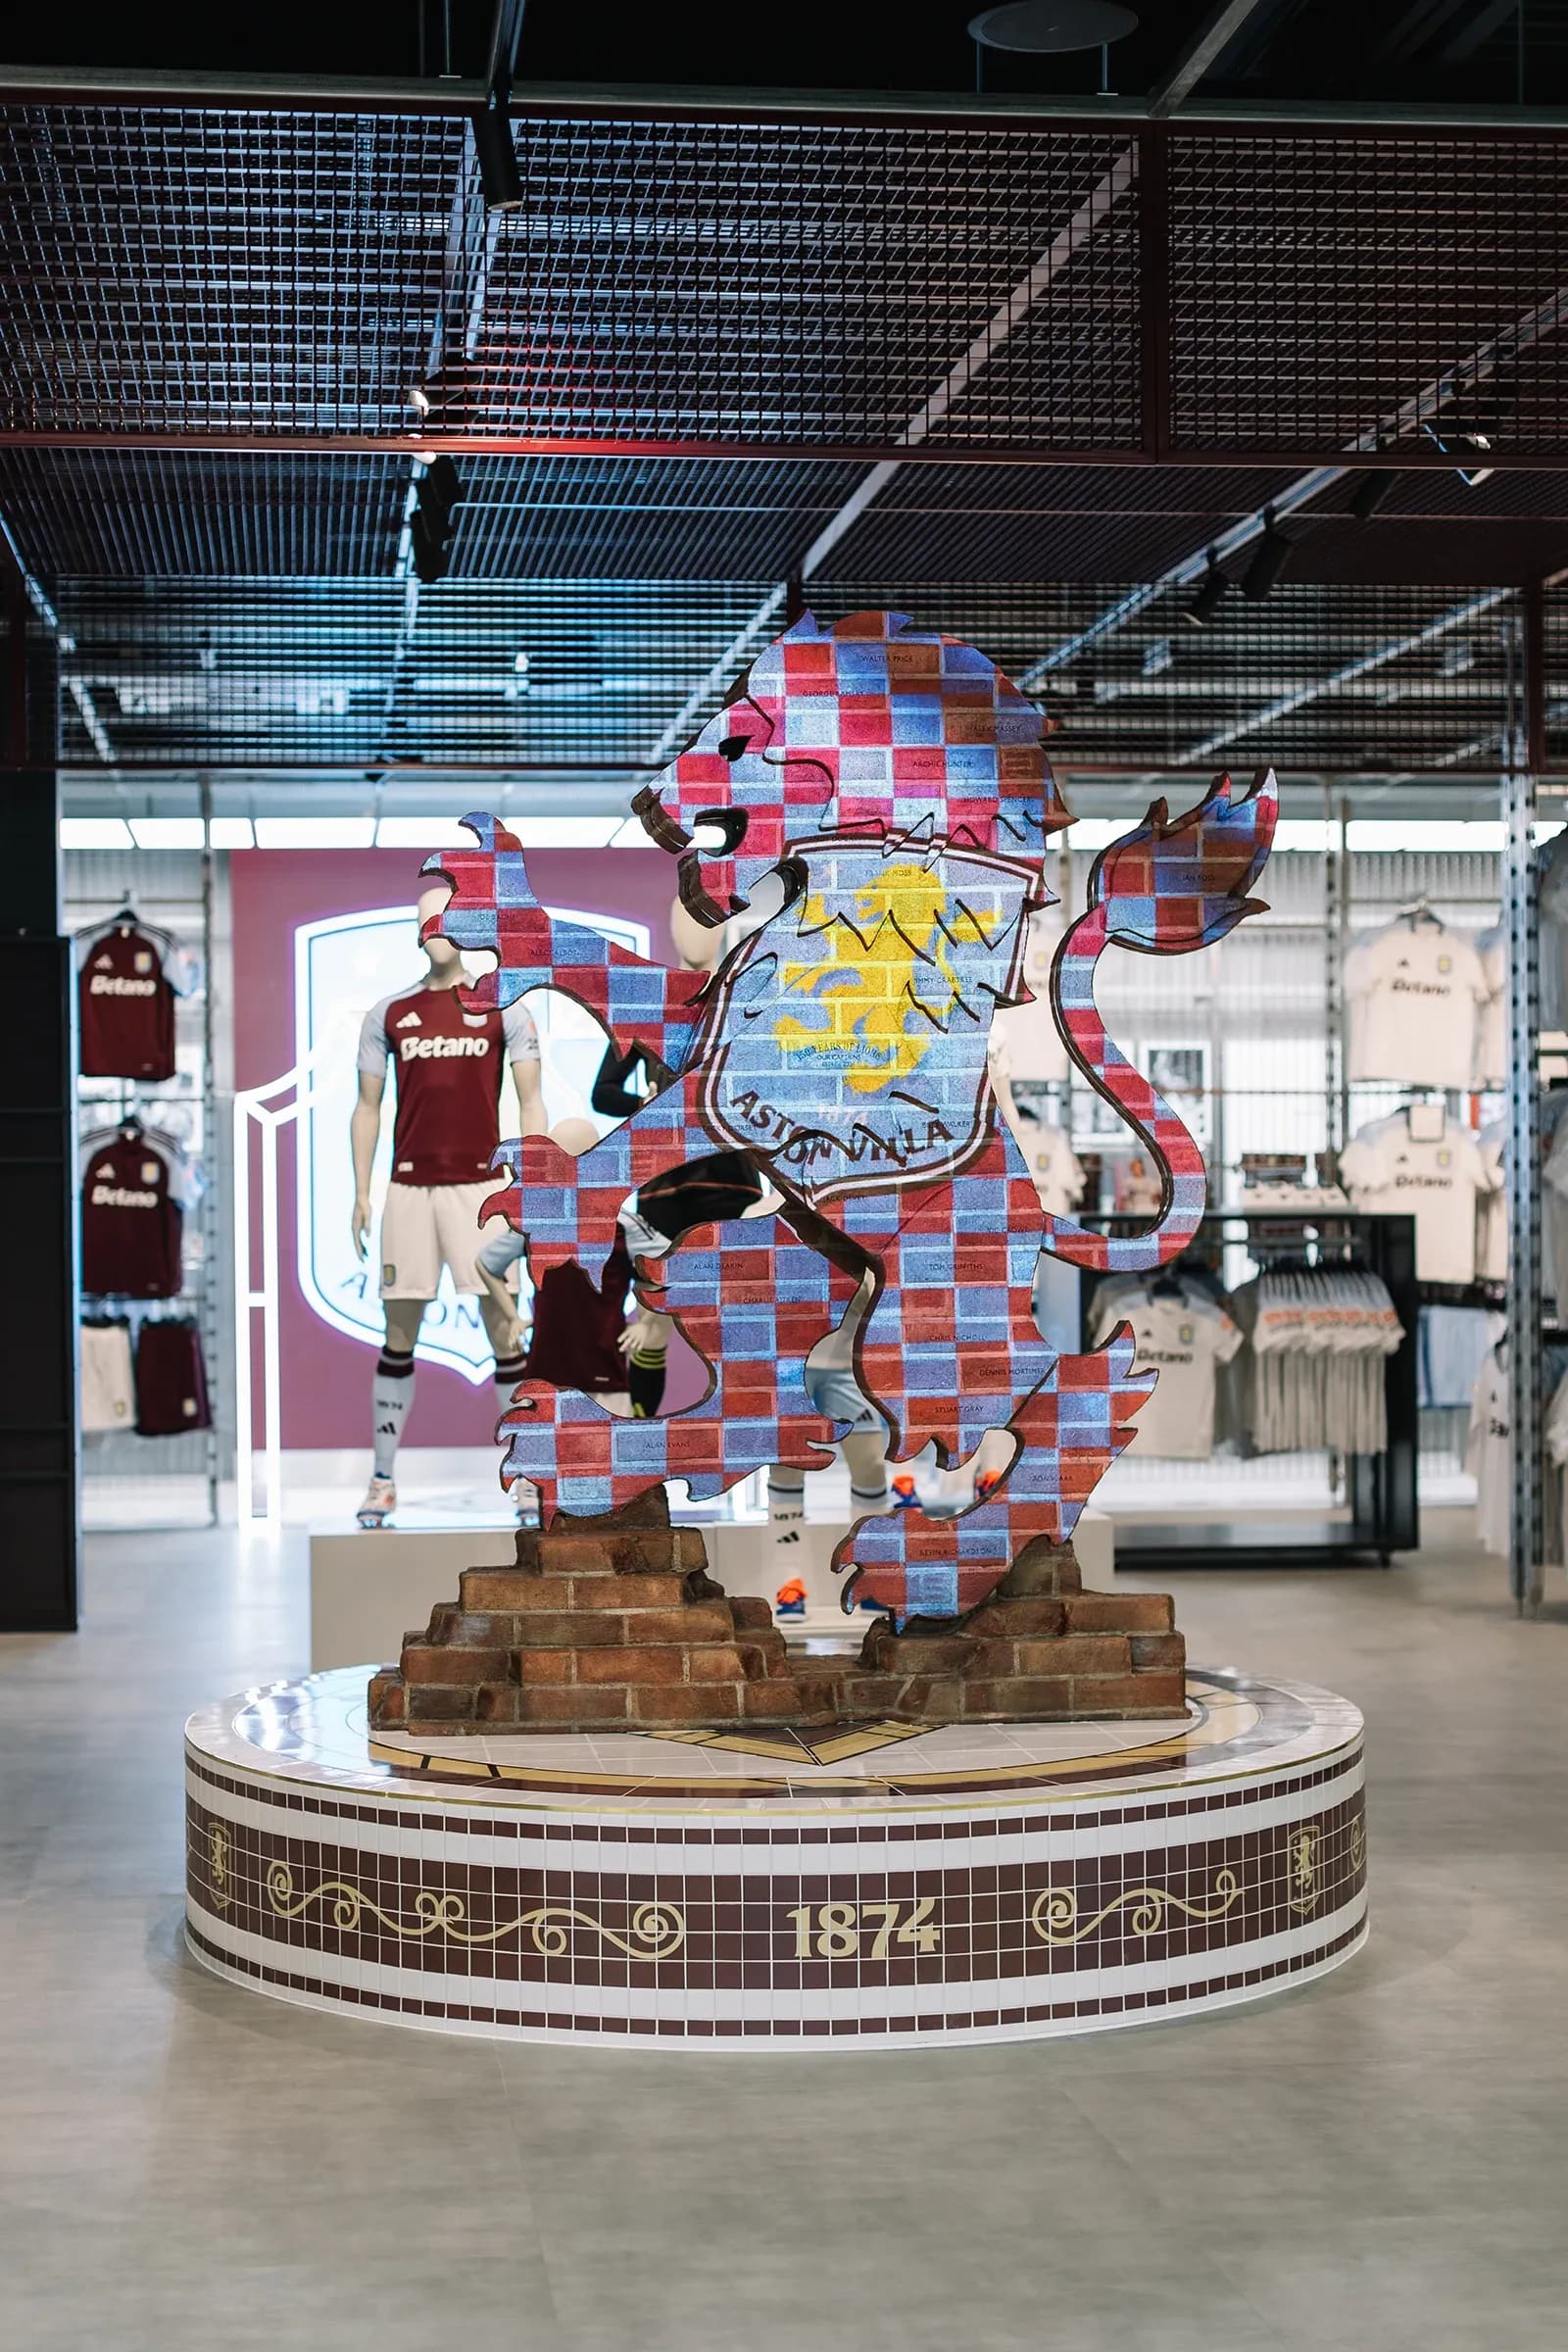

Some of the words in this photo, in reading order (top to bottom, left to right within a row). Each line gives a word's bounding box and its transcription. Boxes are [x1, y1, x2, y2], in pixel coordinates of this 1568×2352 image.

[90, 975, 156, 996] Betano
[400, 1035, 489, 1061] Betano
[729, 1090, 832, 1166] ASTON
[847, 1119, 955, 1163] VILLA
[92, 1185, 158, 1208] Betano
[979, 1368, 1007, 1377] DENNIS
[1007, 1366, 1046, 1376] MORTIMER
[786, 1898, 941, 1959] 1874
